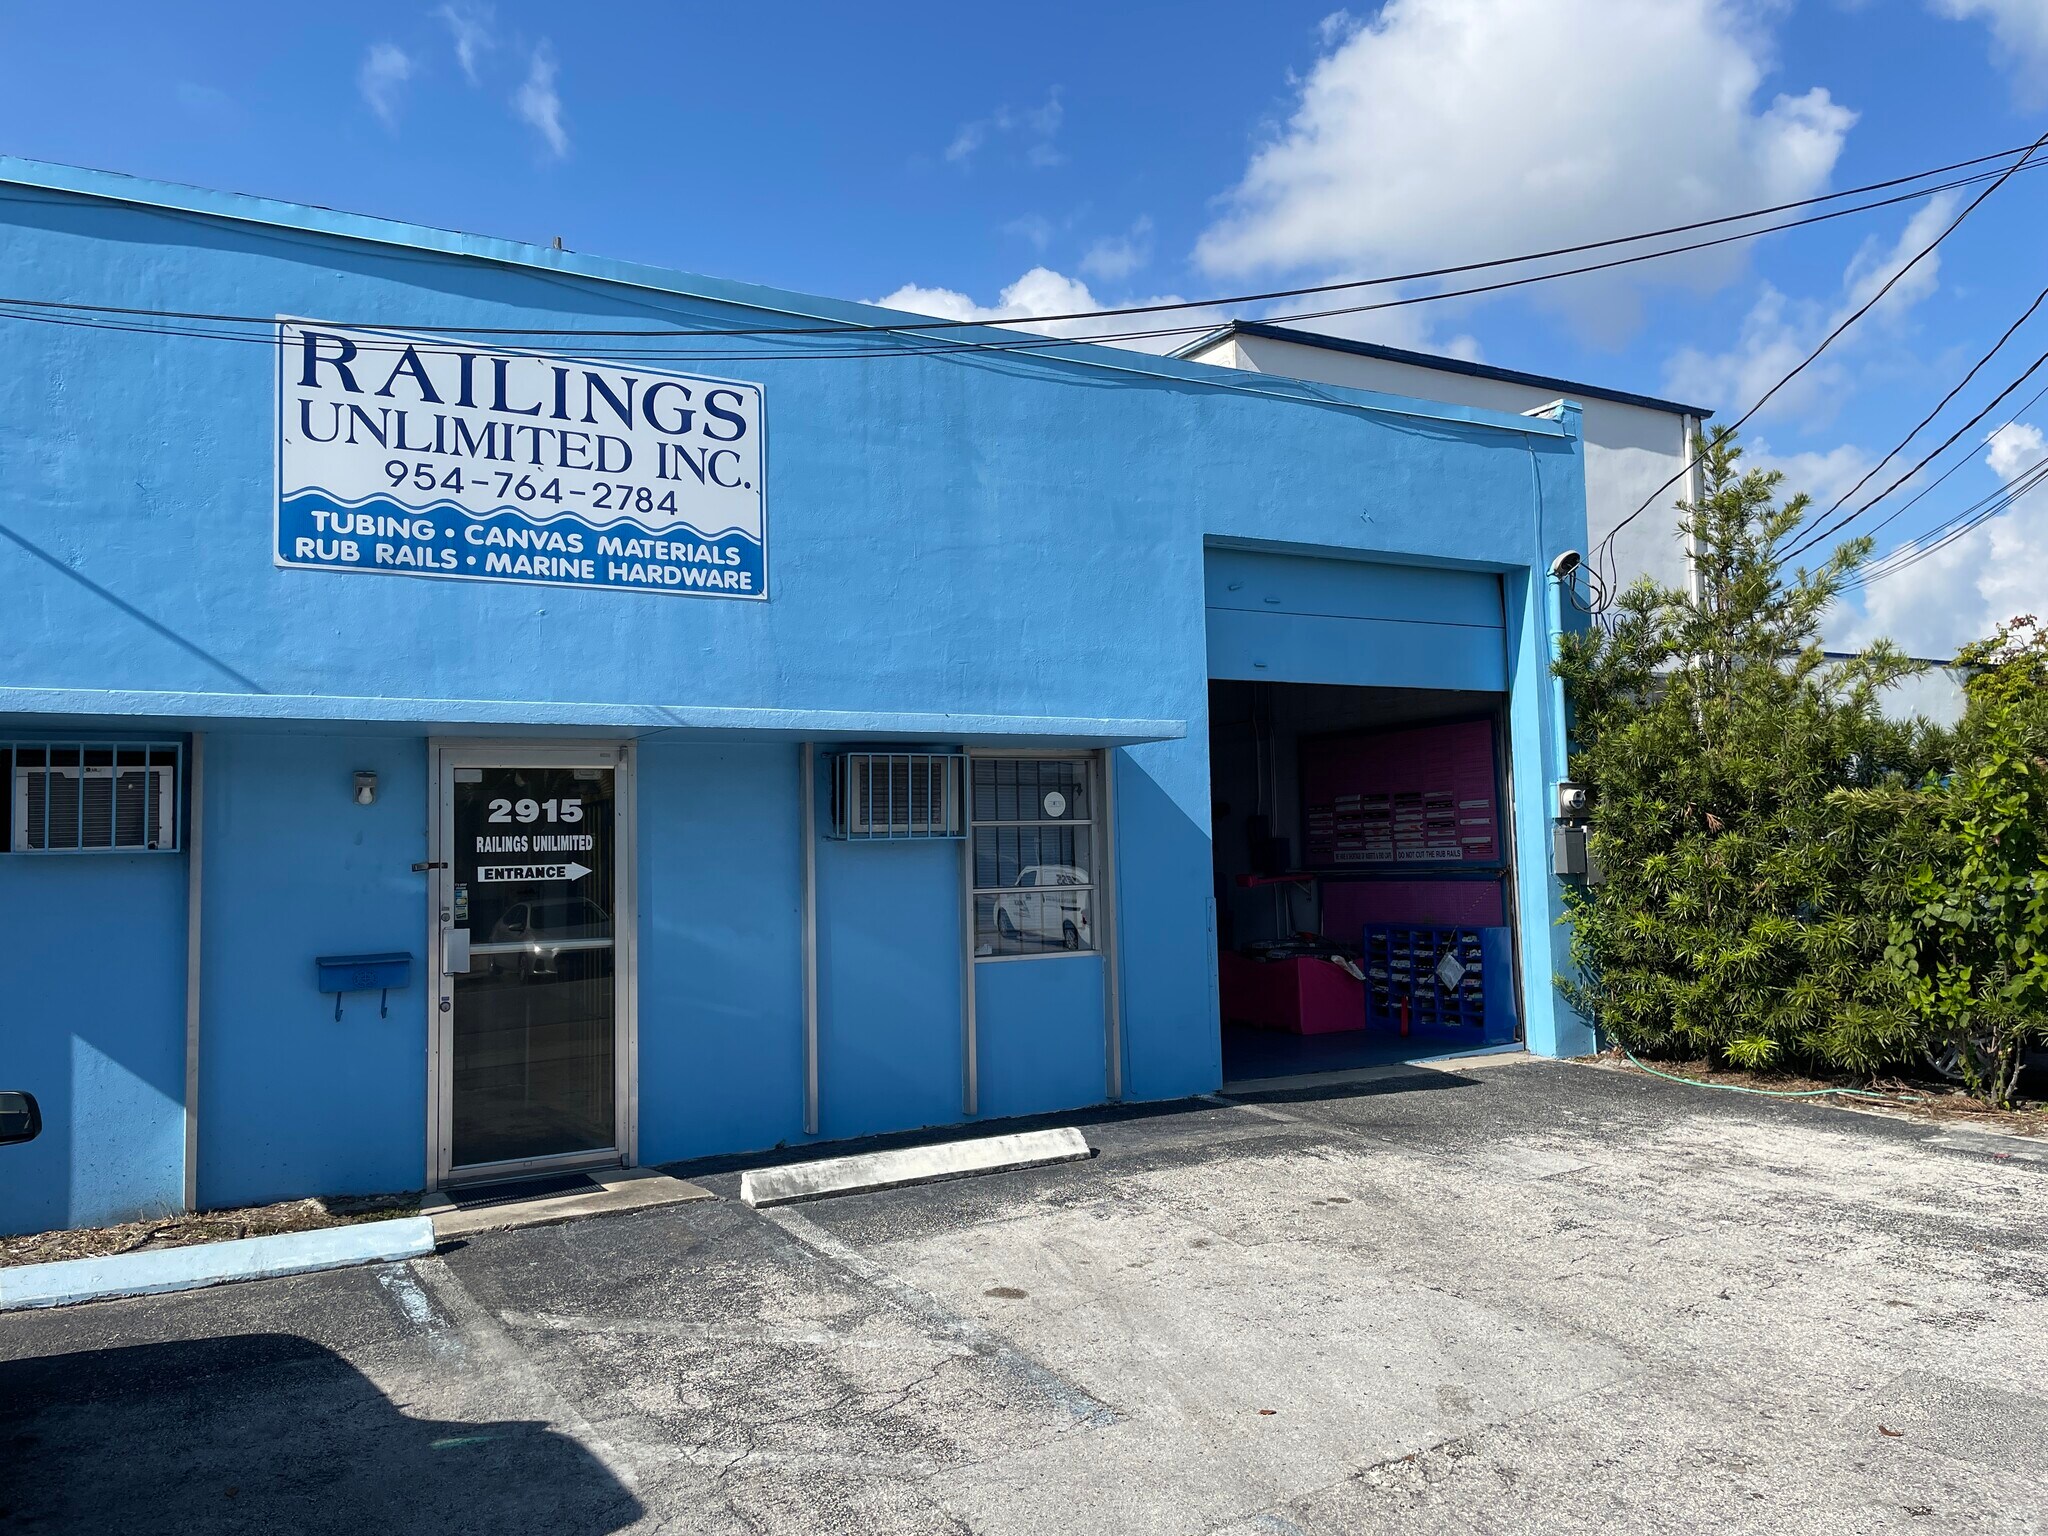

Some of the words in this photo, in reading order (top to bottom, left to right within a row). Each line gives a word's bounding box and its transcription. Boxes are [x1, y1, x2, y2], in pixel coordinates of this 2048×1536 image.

[296, 329, 747, 442] RAILINGS
[297, 398, 633, 474] UNLIMITED
[656, 441, 751, 490] INC.
[384, 459, 678, 516] 954-764-2784
[295, 537, 360, 562] RUB
[375, 543, 458, 570] RAILS
[485, 552, 595, 580] MARINE
[608, 561, 753, 590] HARDWARE
[311, 510, 435, 540] TUBING
[464, 524, 583, 553] CANVAS
[597, 535, 741, 566] MATERIALS
[487, 798, 584, 824] 2915
[476, 835, 529, 853] RAILINGS
[1397, 851, 1405, 859] DO
[1405, 851, 1415, 859] NOT
[1415, 850, 1425, 858] CUT
[1425, 850, 1435, 858] THE
[1435, 850, 1446, 858] RUB
[1446, 849, 1461, 858] RAILS
[484, 866, 566, 880] ENTRANCE
